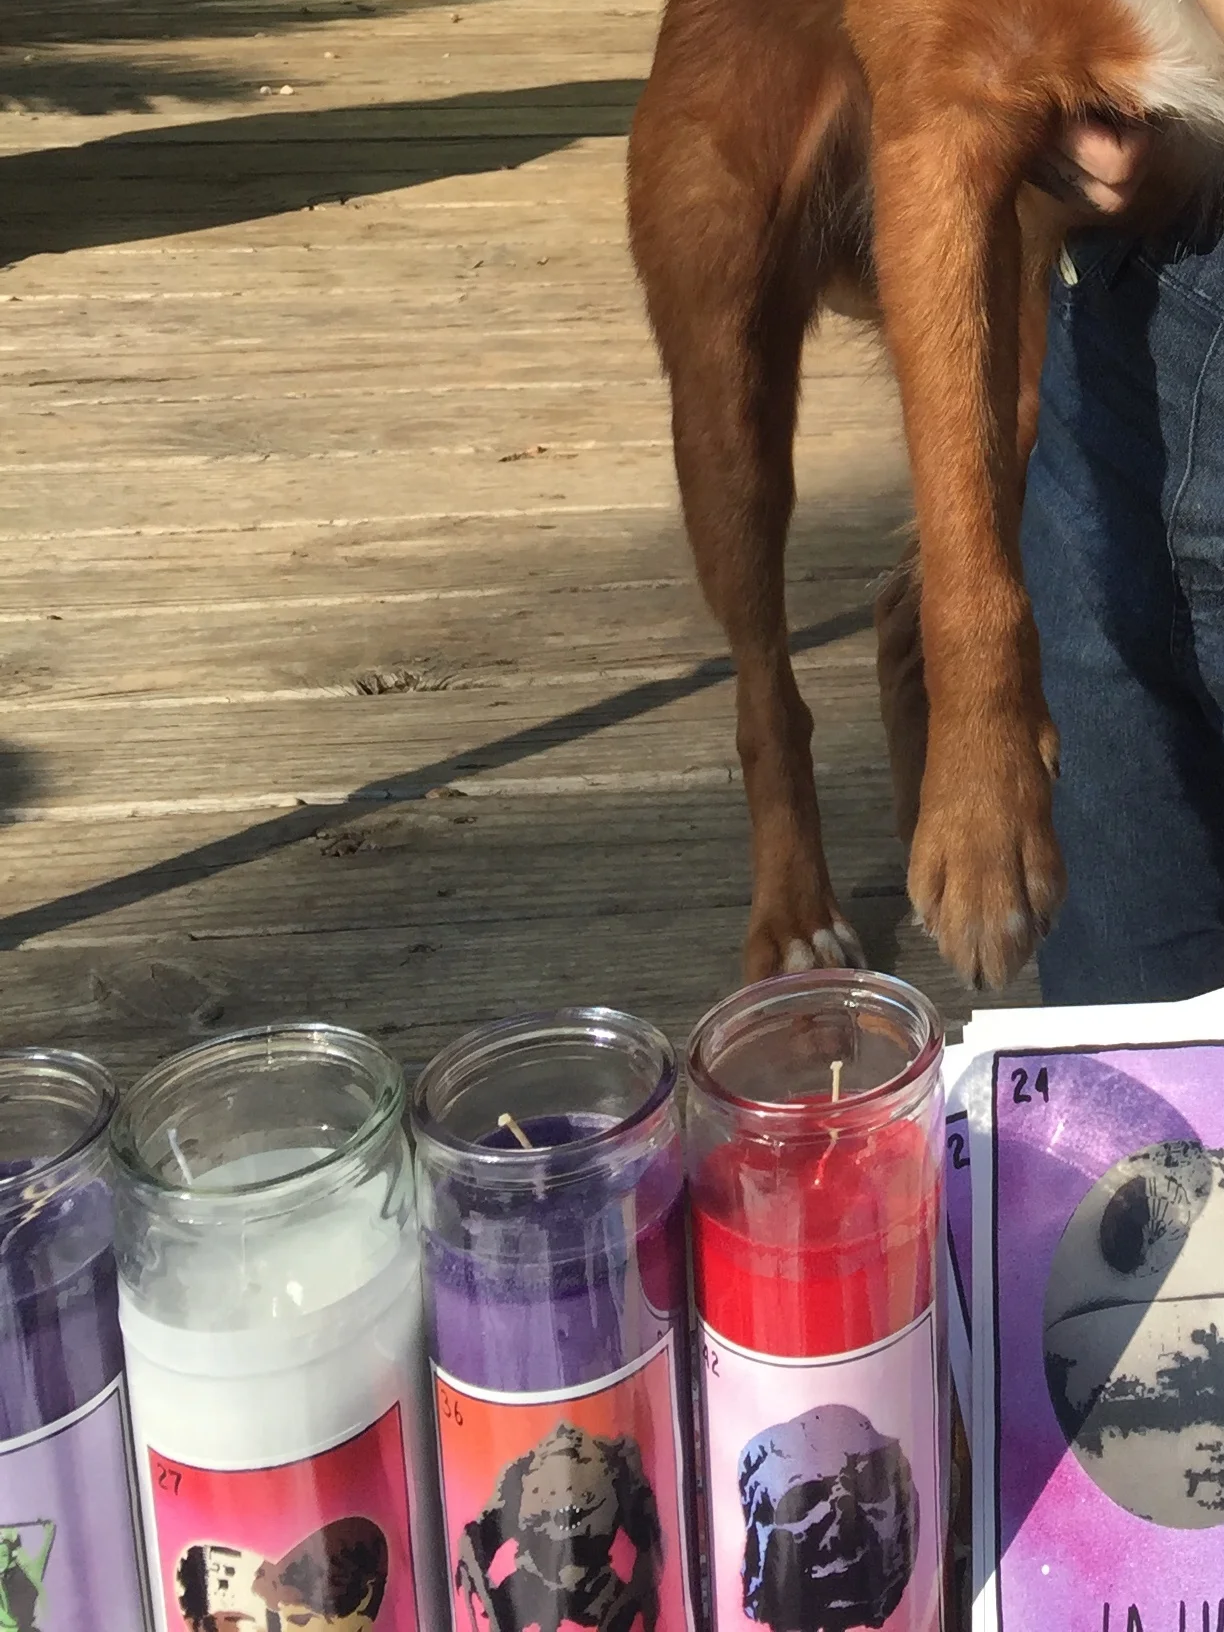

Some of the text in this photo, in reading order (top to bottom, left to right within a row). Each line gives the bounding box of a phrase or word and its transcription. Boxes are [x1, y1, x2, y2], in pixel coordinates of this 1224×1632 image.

[1010, 1067, 1050, 1104] 24
[439, 1388, 464, 1426] 36
[155, 1461, 183, 1496] 27
